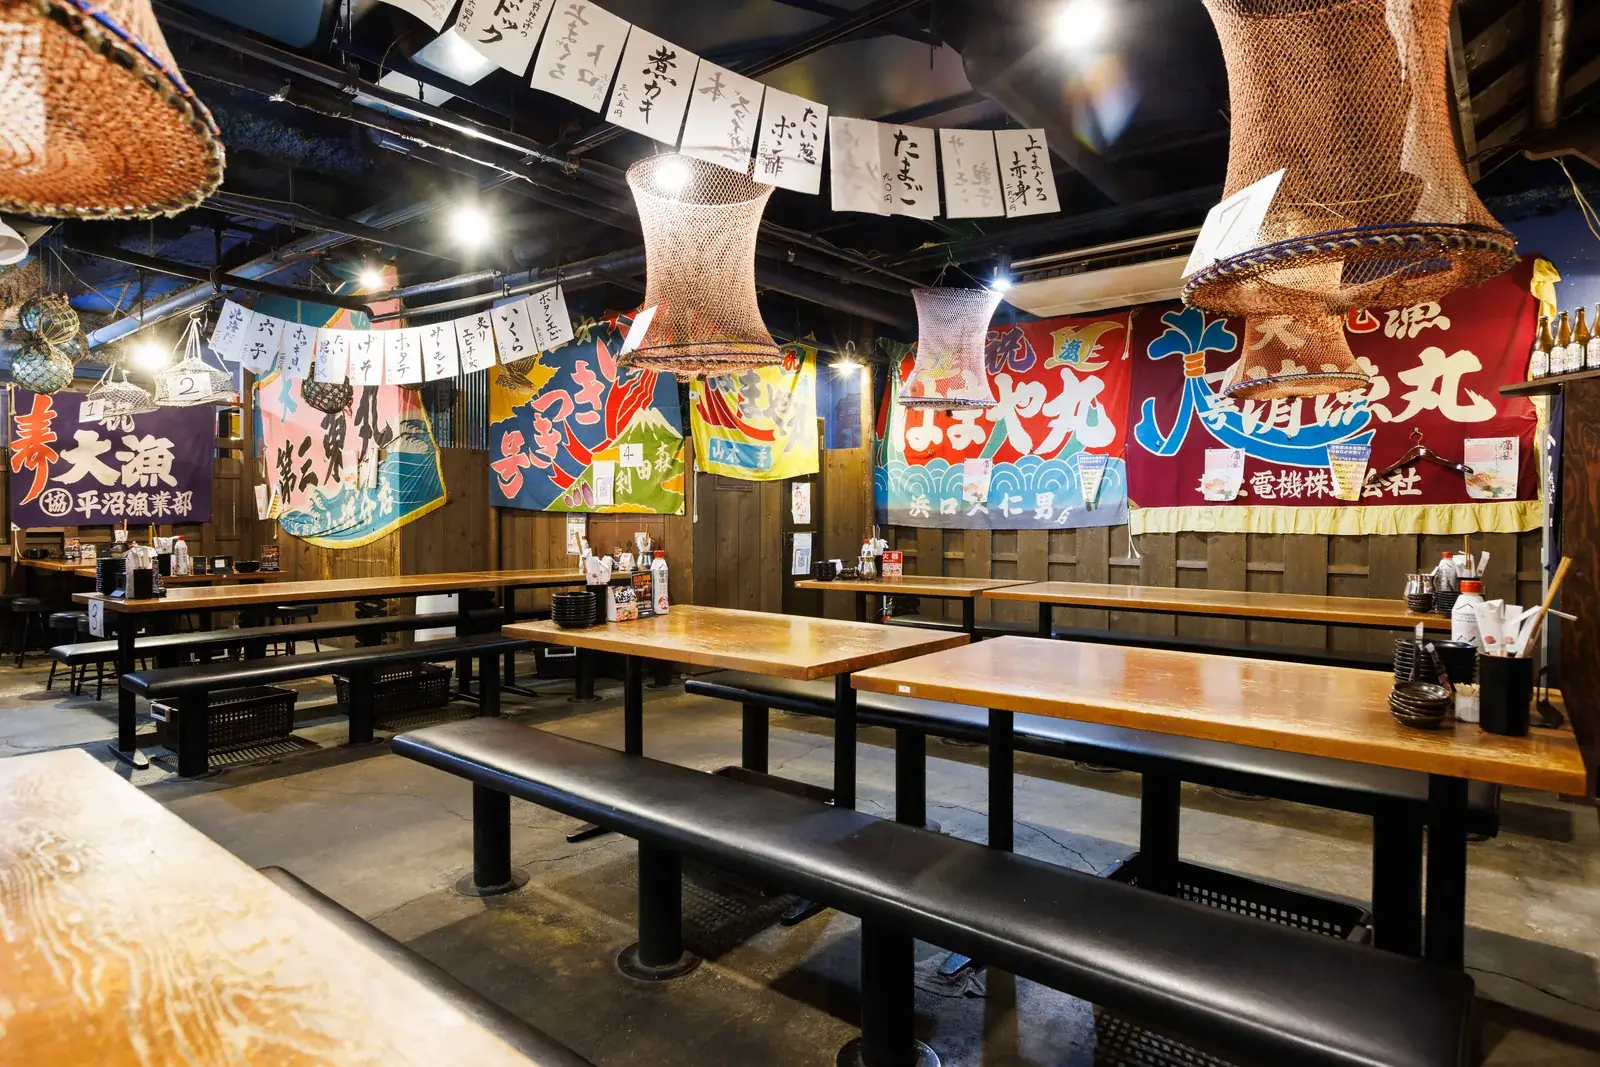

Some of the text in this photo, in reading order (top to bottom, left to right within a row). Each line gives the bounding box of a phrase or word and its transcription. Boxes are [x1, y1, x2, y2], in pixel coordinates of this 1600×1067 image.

[613, 84, 629, 117] 三八五円
[638, 45, 677, 125] 煮カキ
[893, 129, 923, 206] たまご
[1009, 151, 1032, 206] 赤身
[1024, 134, 1048, 202] 上まぐろ
[250, 318, 275, 360] 穴子
[476, 316, 490, 343] 炙り
[501, 308, 525, 353] いくら
[539, 291, 562, 341] ボタンエビ
[394, 332, 411, 379] ホタテ
[430, 326, 446, 376] サーモン
[985, 326, 1037, 375] 祝
[86, 402, 95, 417] 1
[178, 377, 200, 396] 2
[50, 429, 178, 488] 大漁
[623, 446, 634, 460] 4
[74, 490, 194, 519] 平沼漁業部
[92, 603, 98, 630] 3
